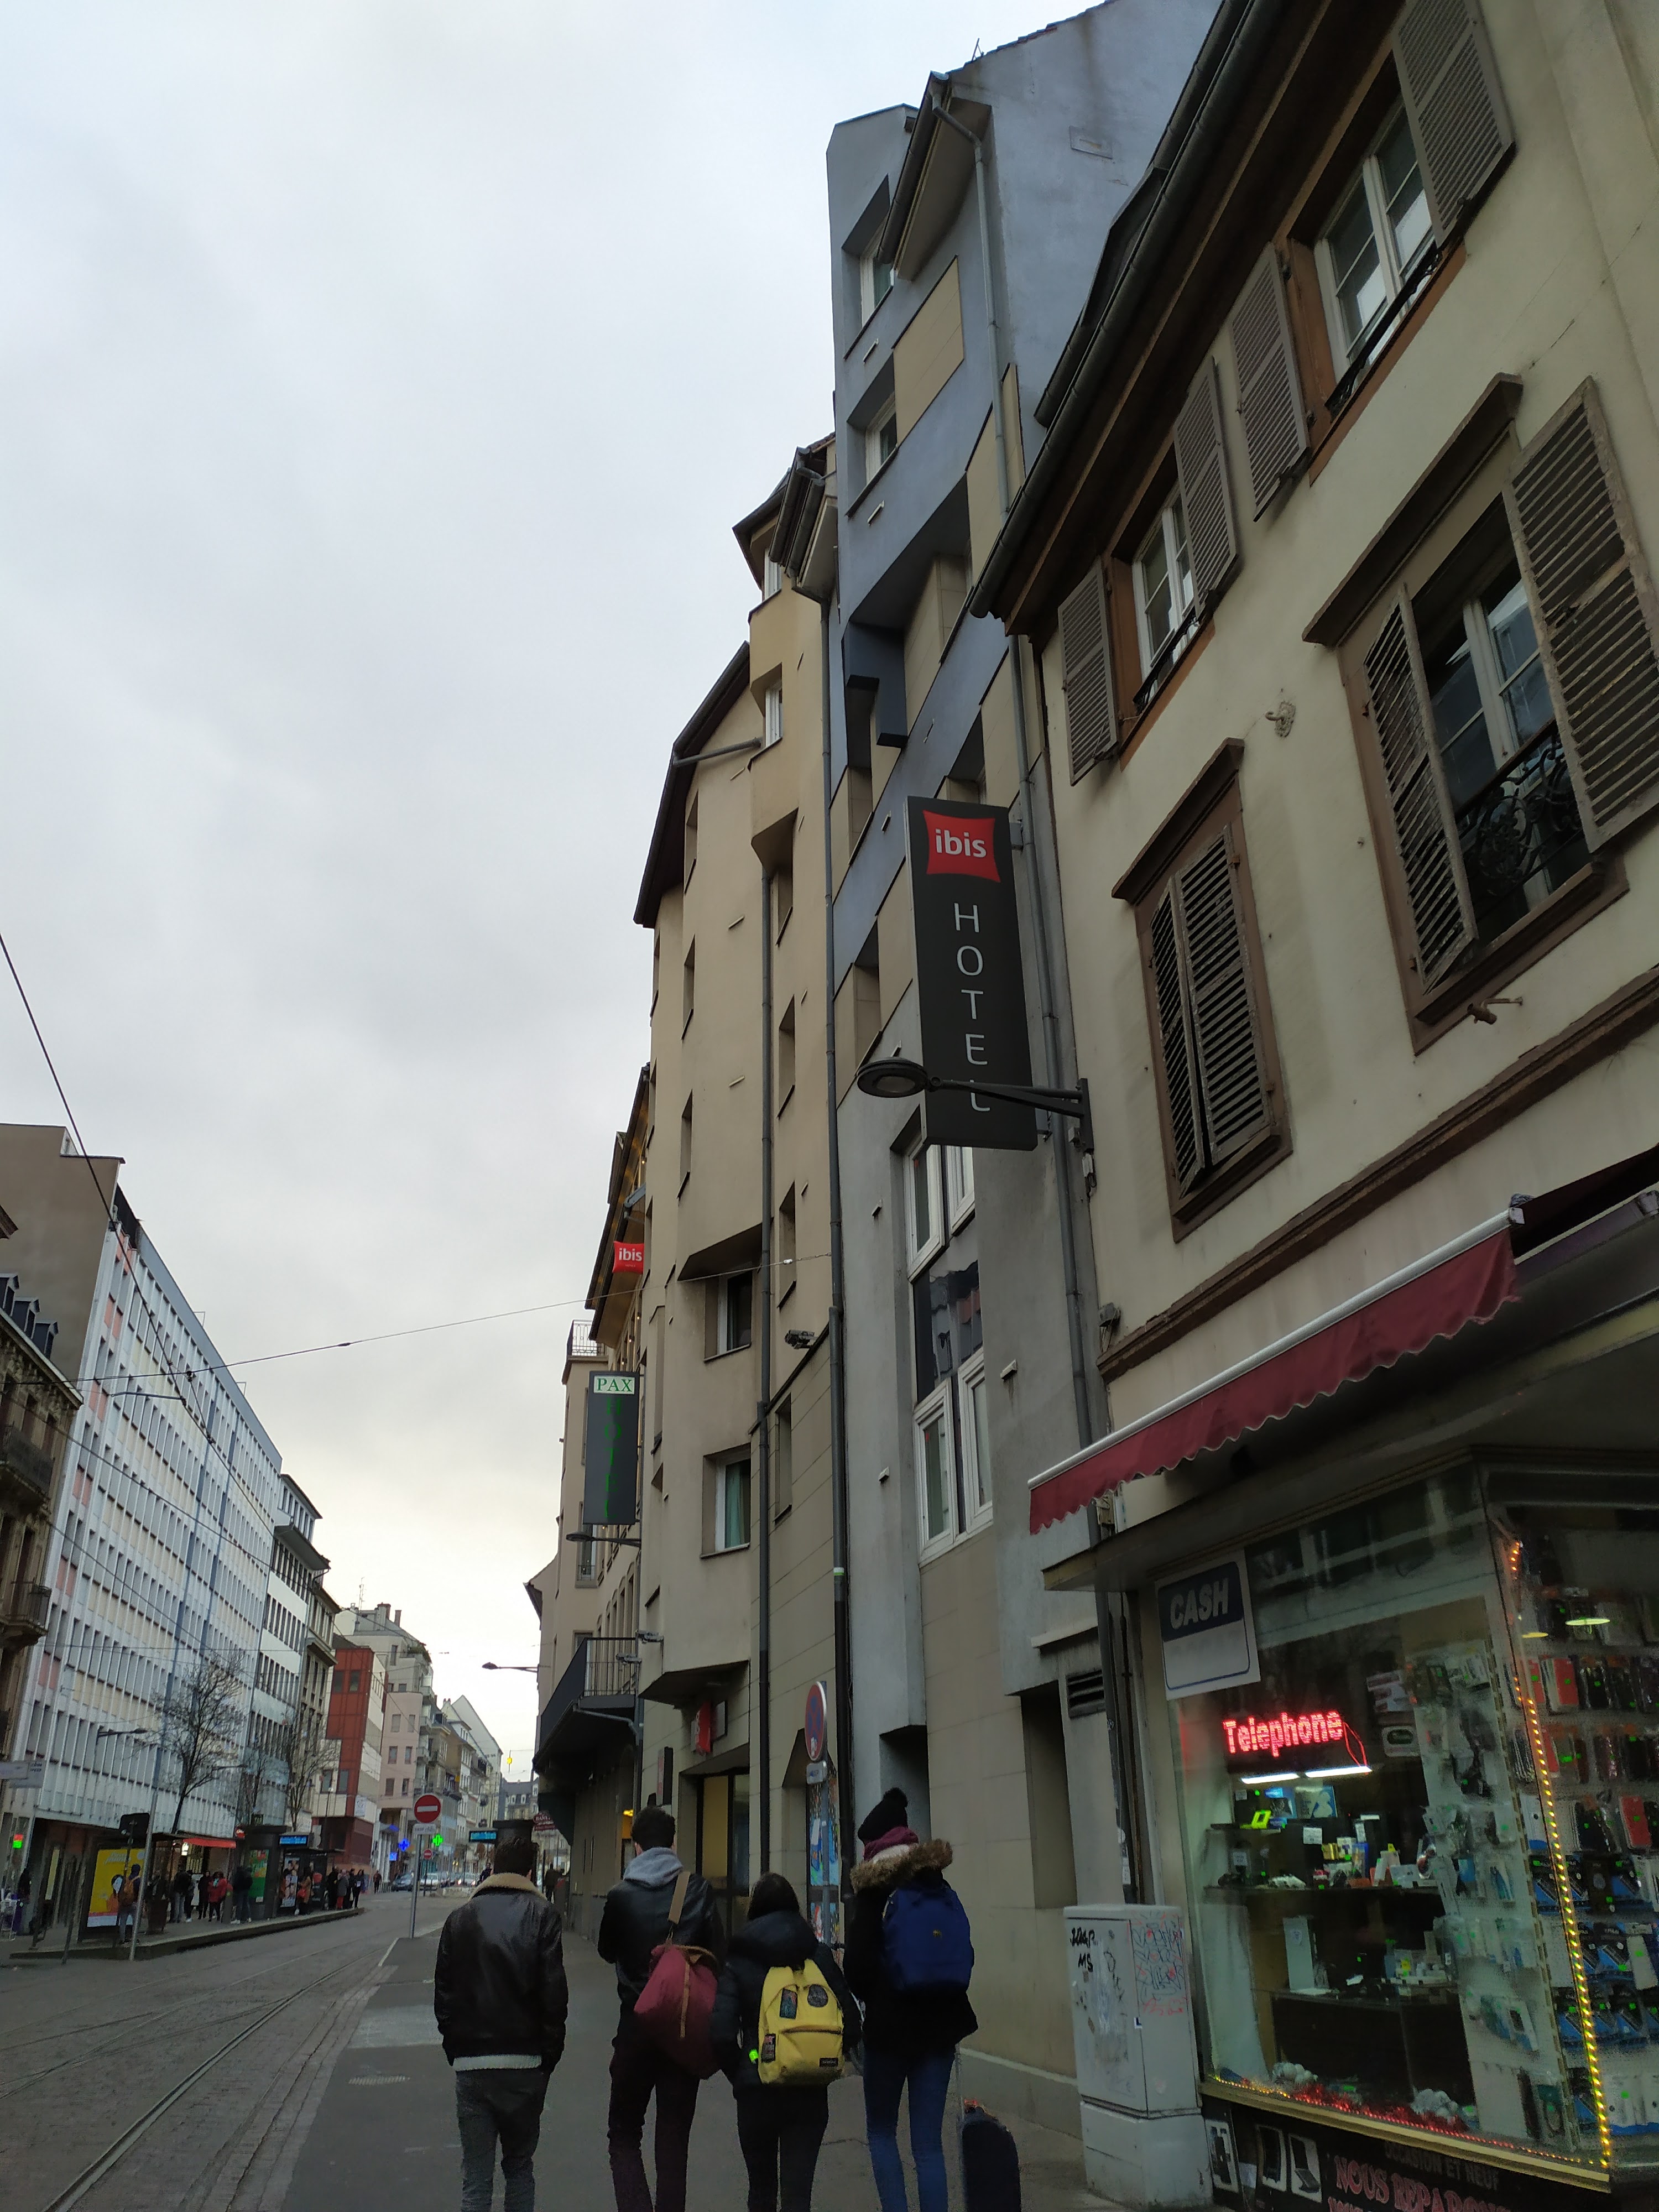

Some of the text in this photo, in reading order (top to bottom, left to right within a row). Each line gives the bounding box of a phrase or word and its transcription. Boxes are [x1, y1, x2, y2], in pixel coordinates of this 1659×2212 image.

[935, 828, 987, 858] ibis
[953, 902, 991, 1112] HOTEL
[619, 1248, 642, 1261] ibis
[596, 1377, 633, 1392] PAX
[604, 1397, 622, 1519] HOTEL
[1170, 1578, 1229, 1629] CASH
[1223, 1711, 1343, 1757] Telephone
[1334, 2154, 1389, 2204] NOUS
